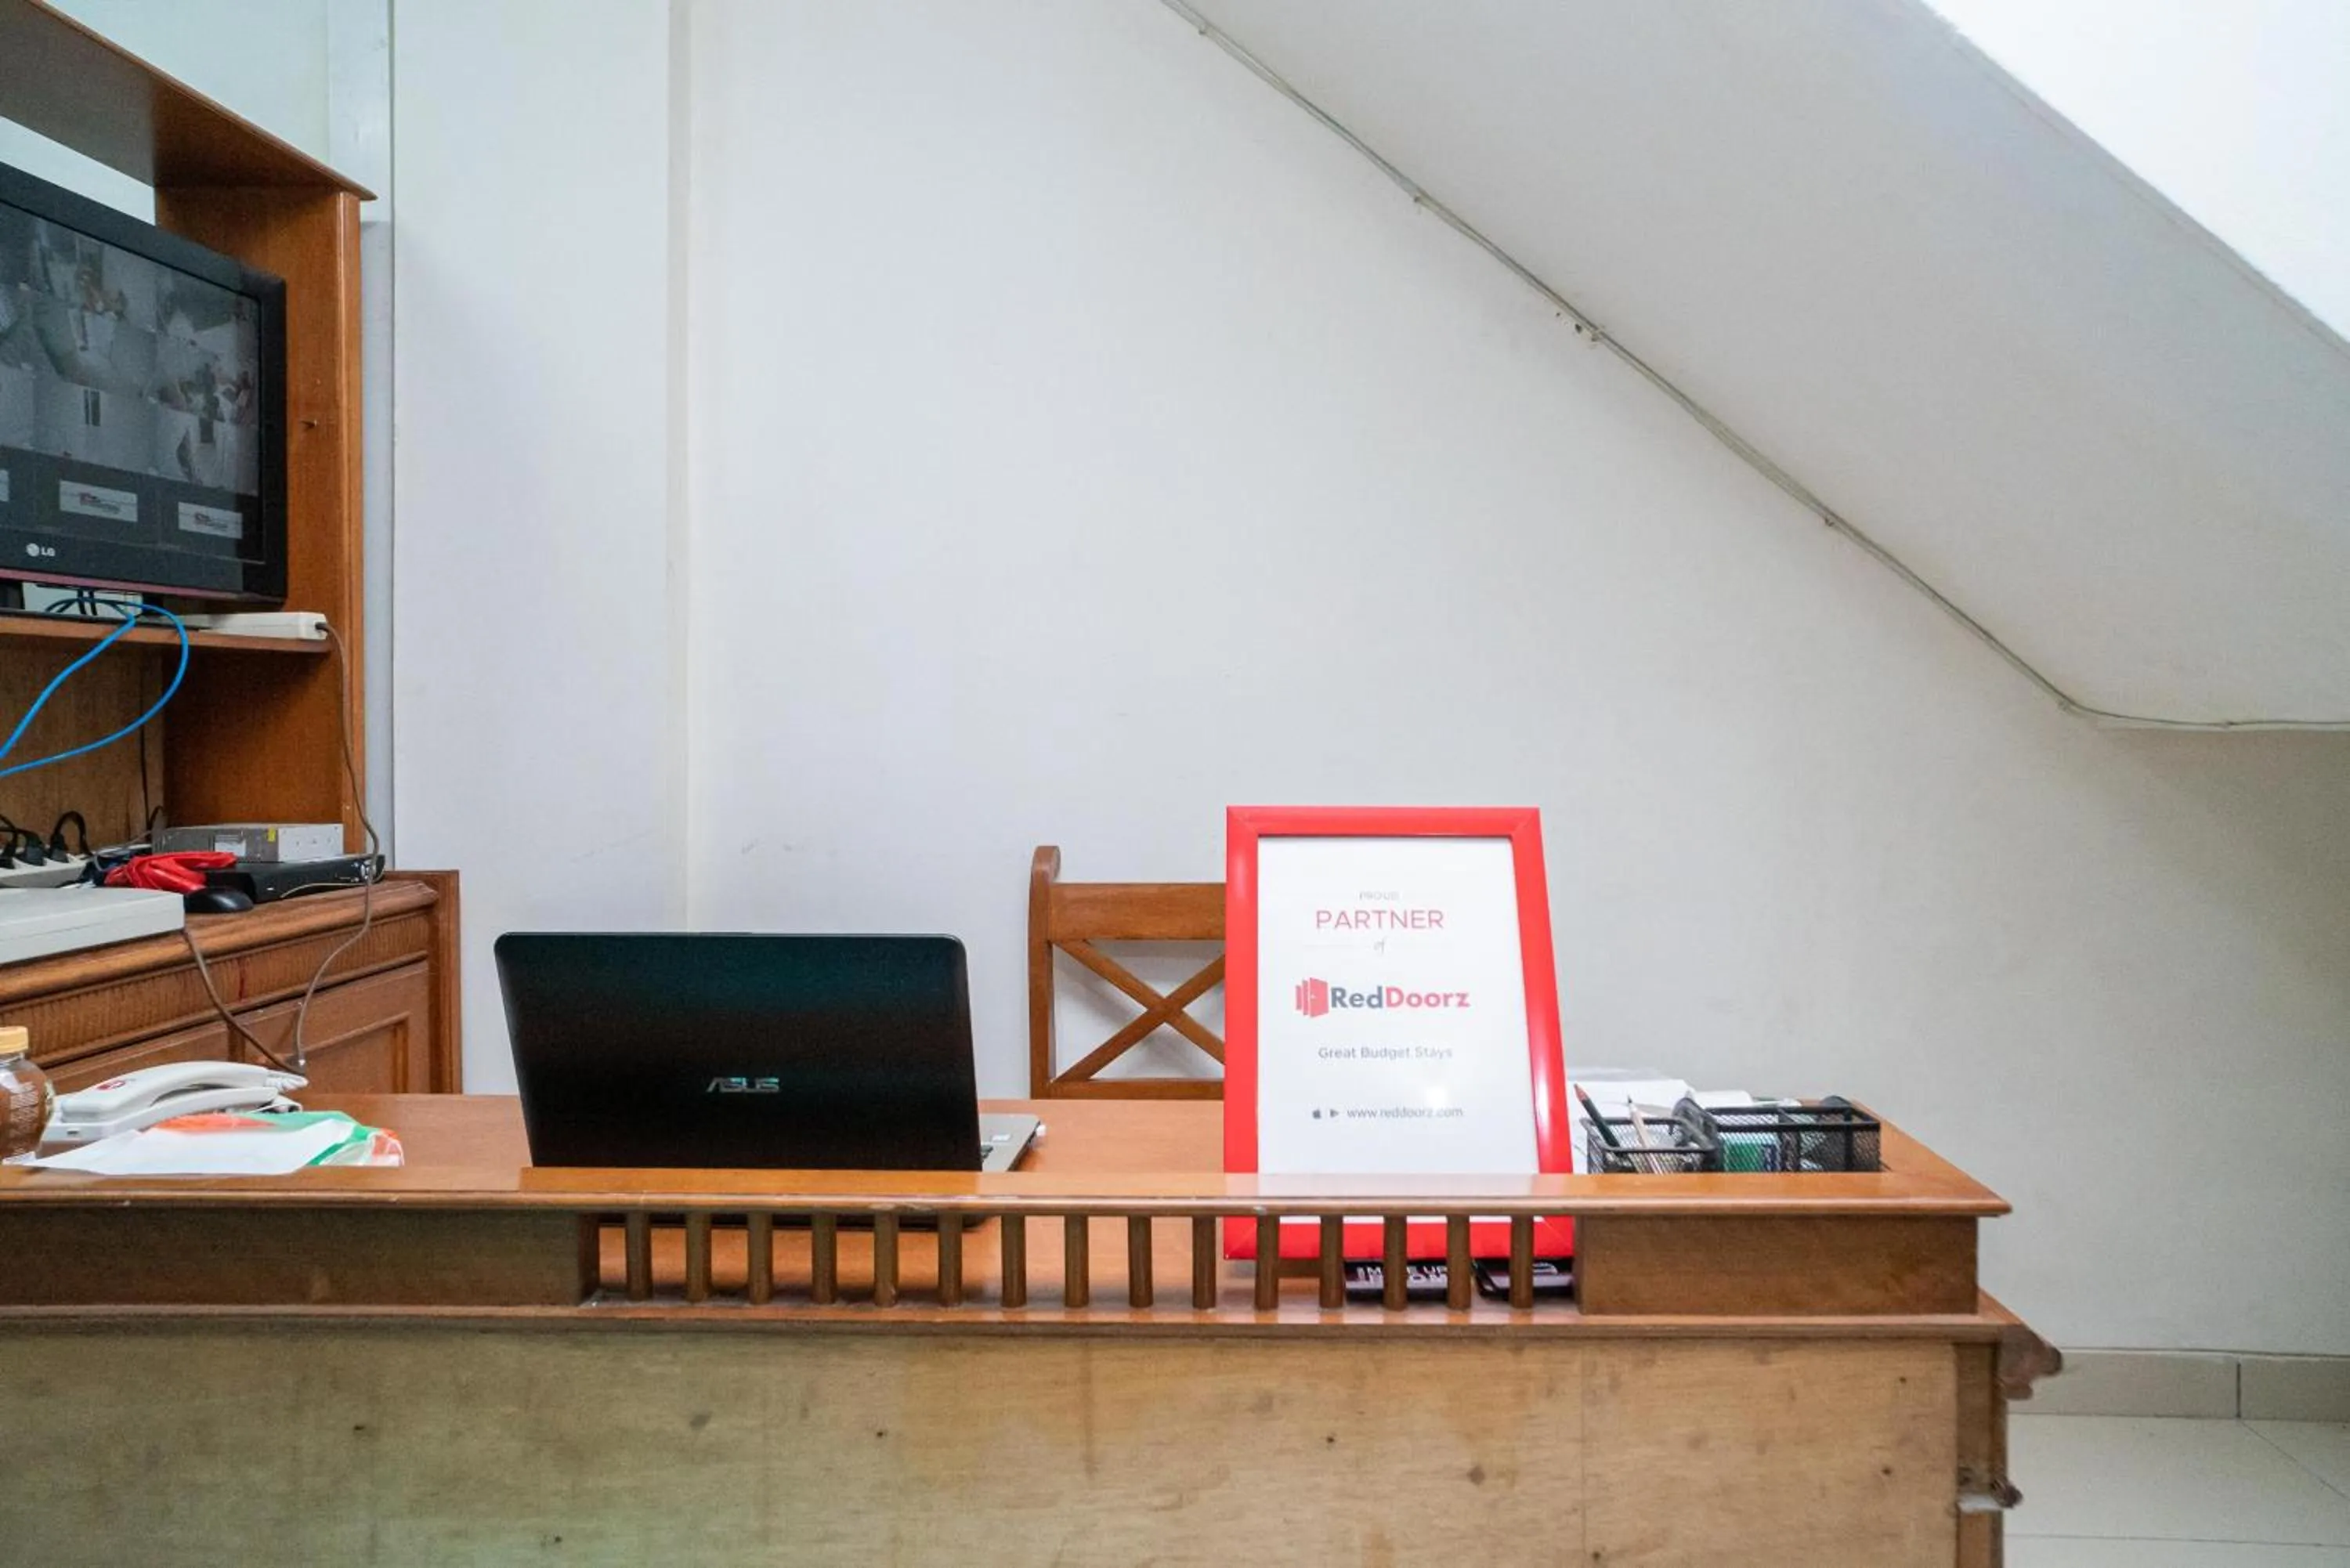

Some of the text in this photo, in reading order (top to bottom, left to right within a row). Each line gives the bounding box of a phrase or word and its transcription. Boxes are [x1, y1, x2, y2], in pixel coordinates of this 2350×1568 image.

[41, 547, 56, 557] LG
[1316, 909, 1444, 929] PARTNER
[1330, 985, 1471, 1009] RedDoorz
[1318, 1046, 1453, 1060] Great Budget Stays
[707, 1077, 779, 1093] ASUS
[1347, 1106, 1464, 1118] www.reddoorz.com
